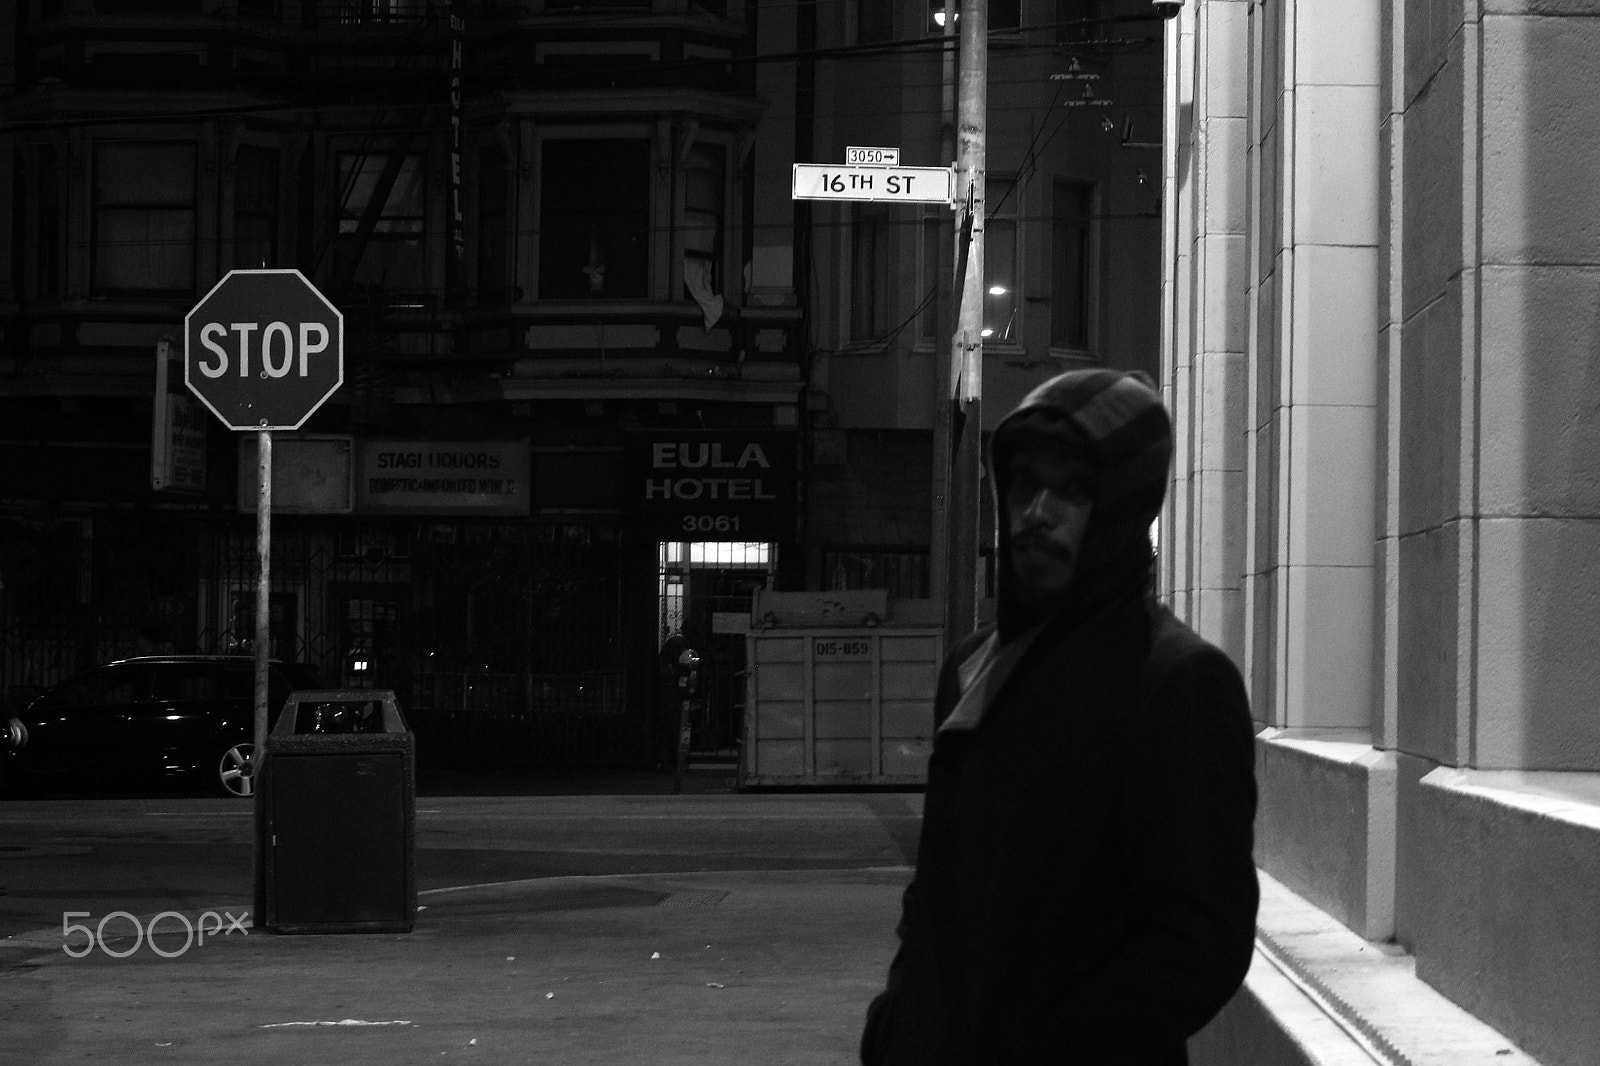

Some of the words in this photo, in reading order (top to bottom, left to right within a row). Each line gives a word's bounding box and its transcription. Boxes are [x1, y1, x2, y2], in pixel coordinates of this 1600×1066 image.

[451, 39, 463, 222] HOTEL
[850, 150, 882, 163] 3050
[822, 174, 873, 193] 16TH
[886, 175, 915, 194] ST
[198, 321, 330, 378] STOP
[652, 443, 770, 468] EULA
[645, 477, 776, 500] HOTEL
[681, 514, 741, 532] 3061
